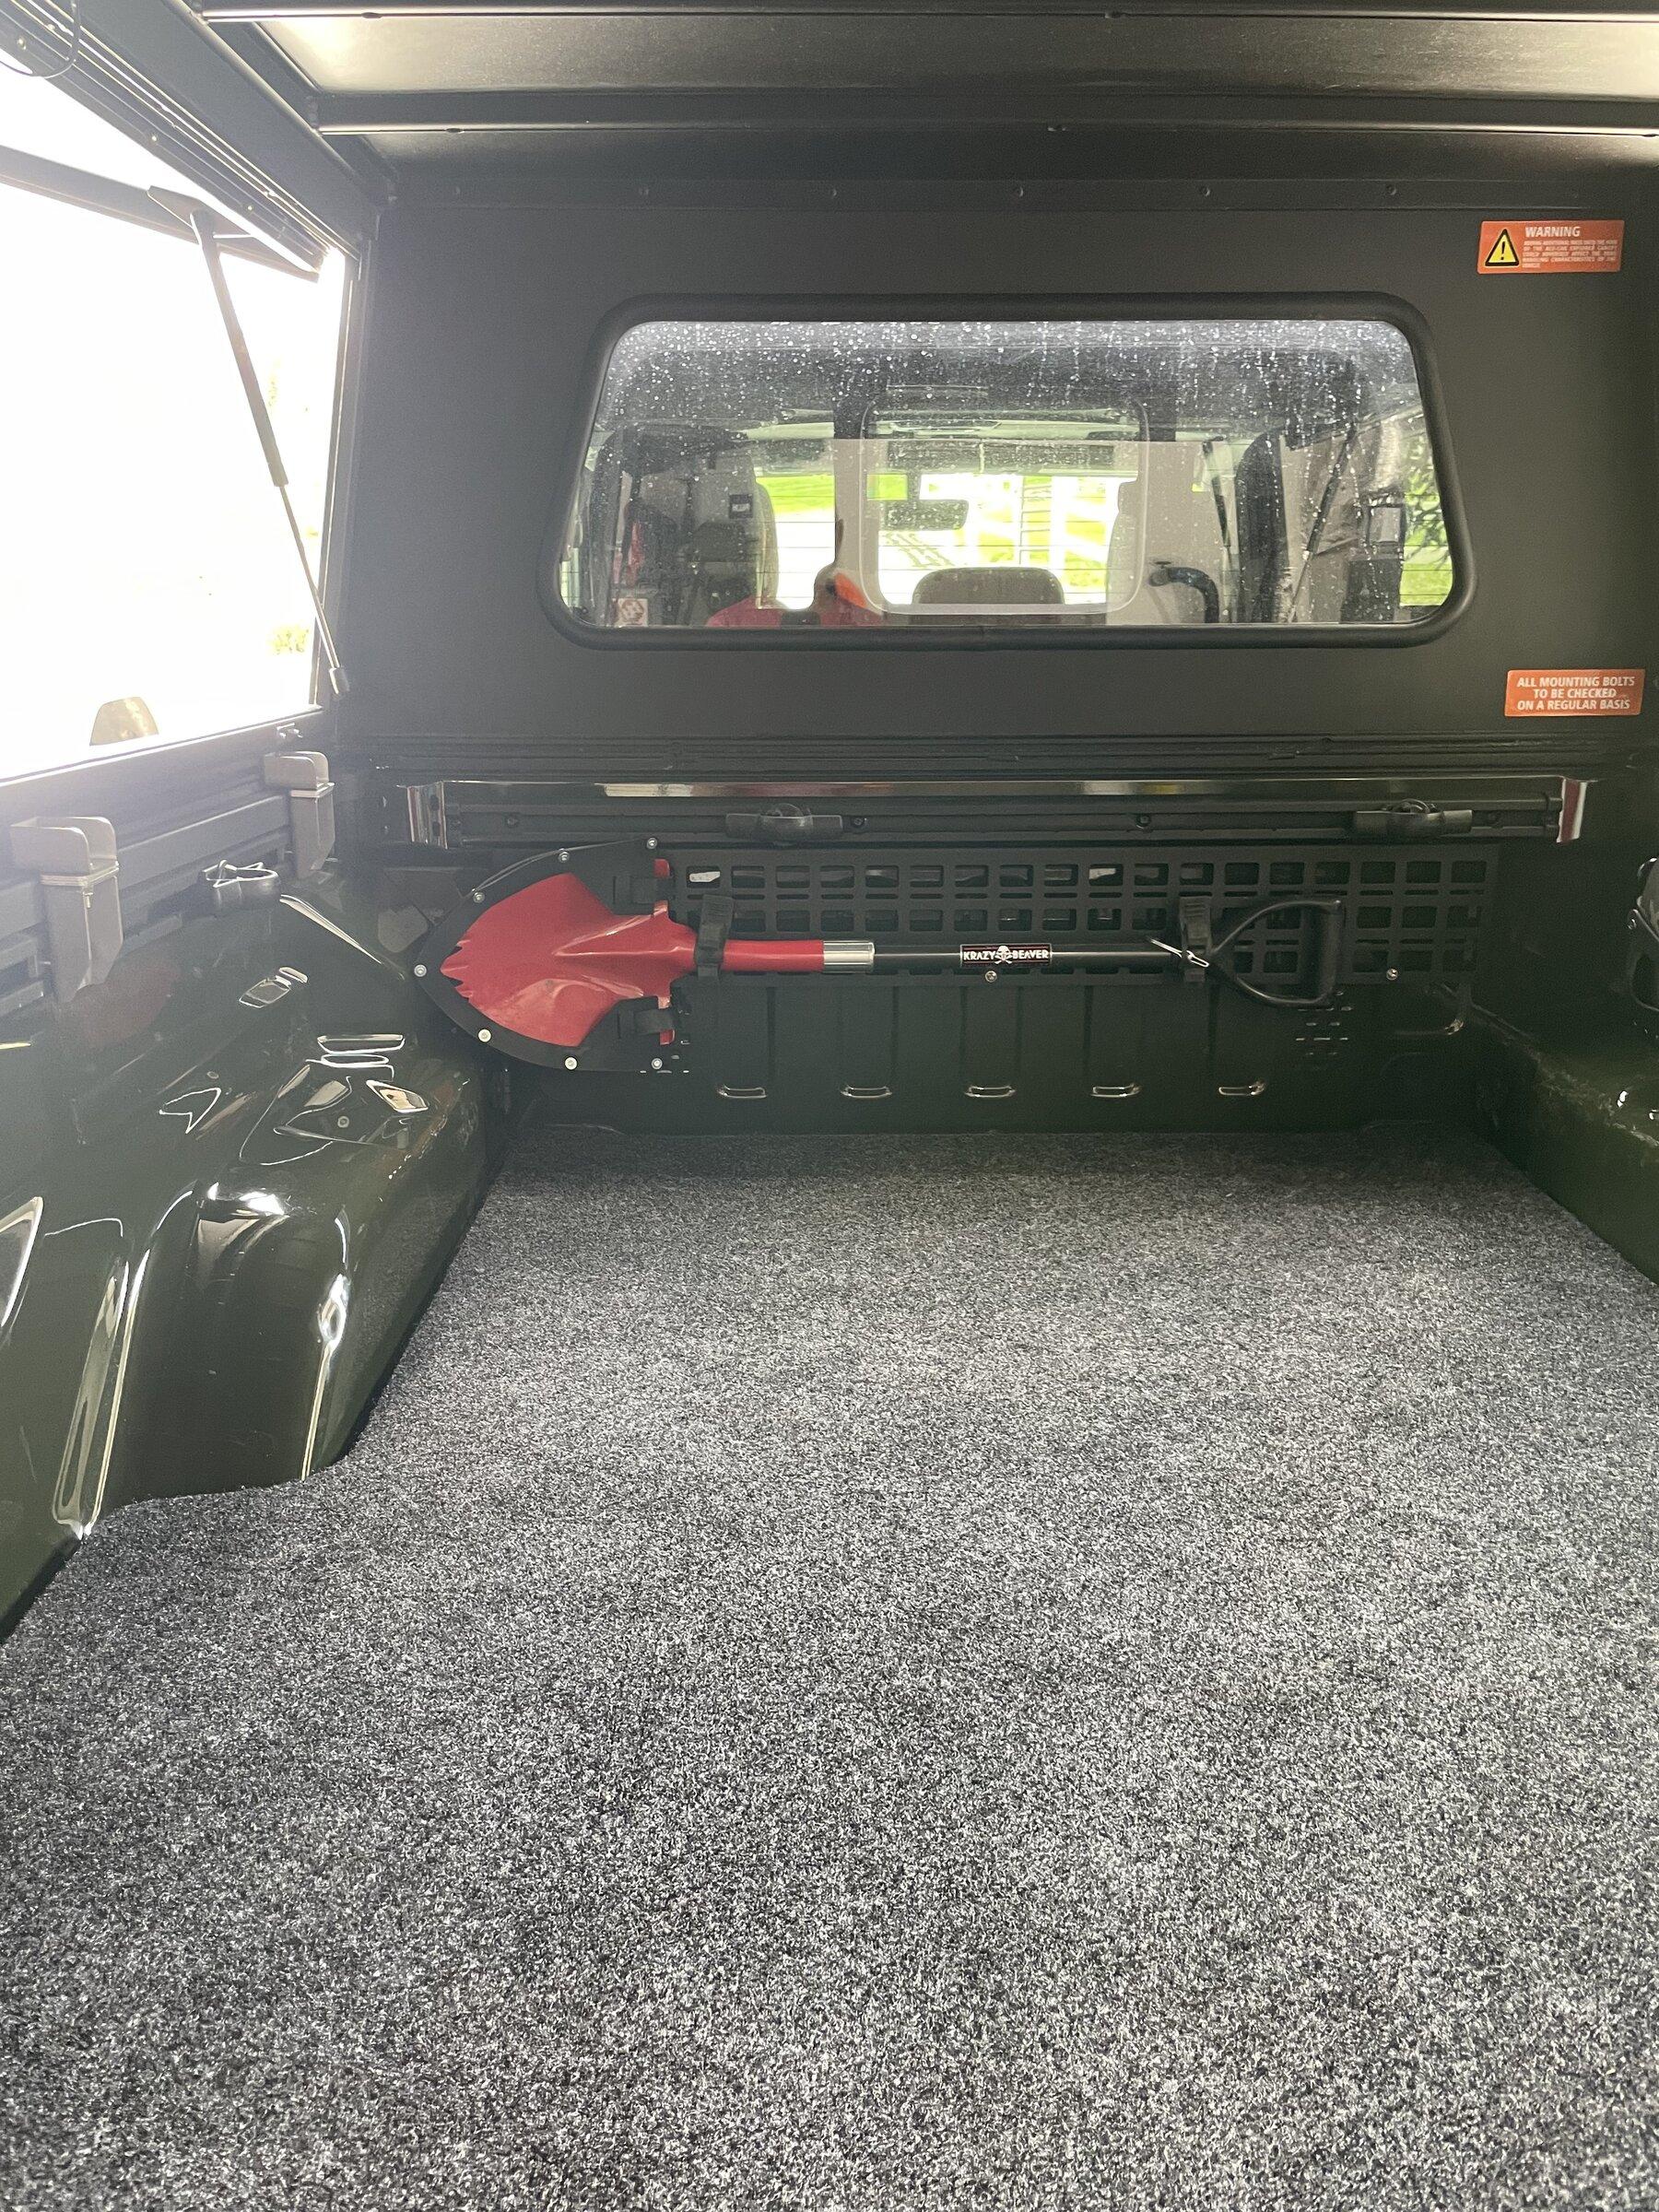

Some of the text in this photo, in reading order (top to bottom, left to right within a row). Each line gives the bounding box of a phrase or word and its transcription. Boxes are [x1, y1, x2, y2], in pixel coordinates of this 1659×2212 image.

[1524, 226, 1582, 238] WARNING
[1516, 676, 1635, 688] ALL MOUNTING BOLTS
[1533, 688, 1617, 699] TO BE CHECKED
[1516, 699, 1630, 711] ON A REGULAR BASIS
[963, 949, 1049, 960] KRAZY BEAVER
